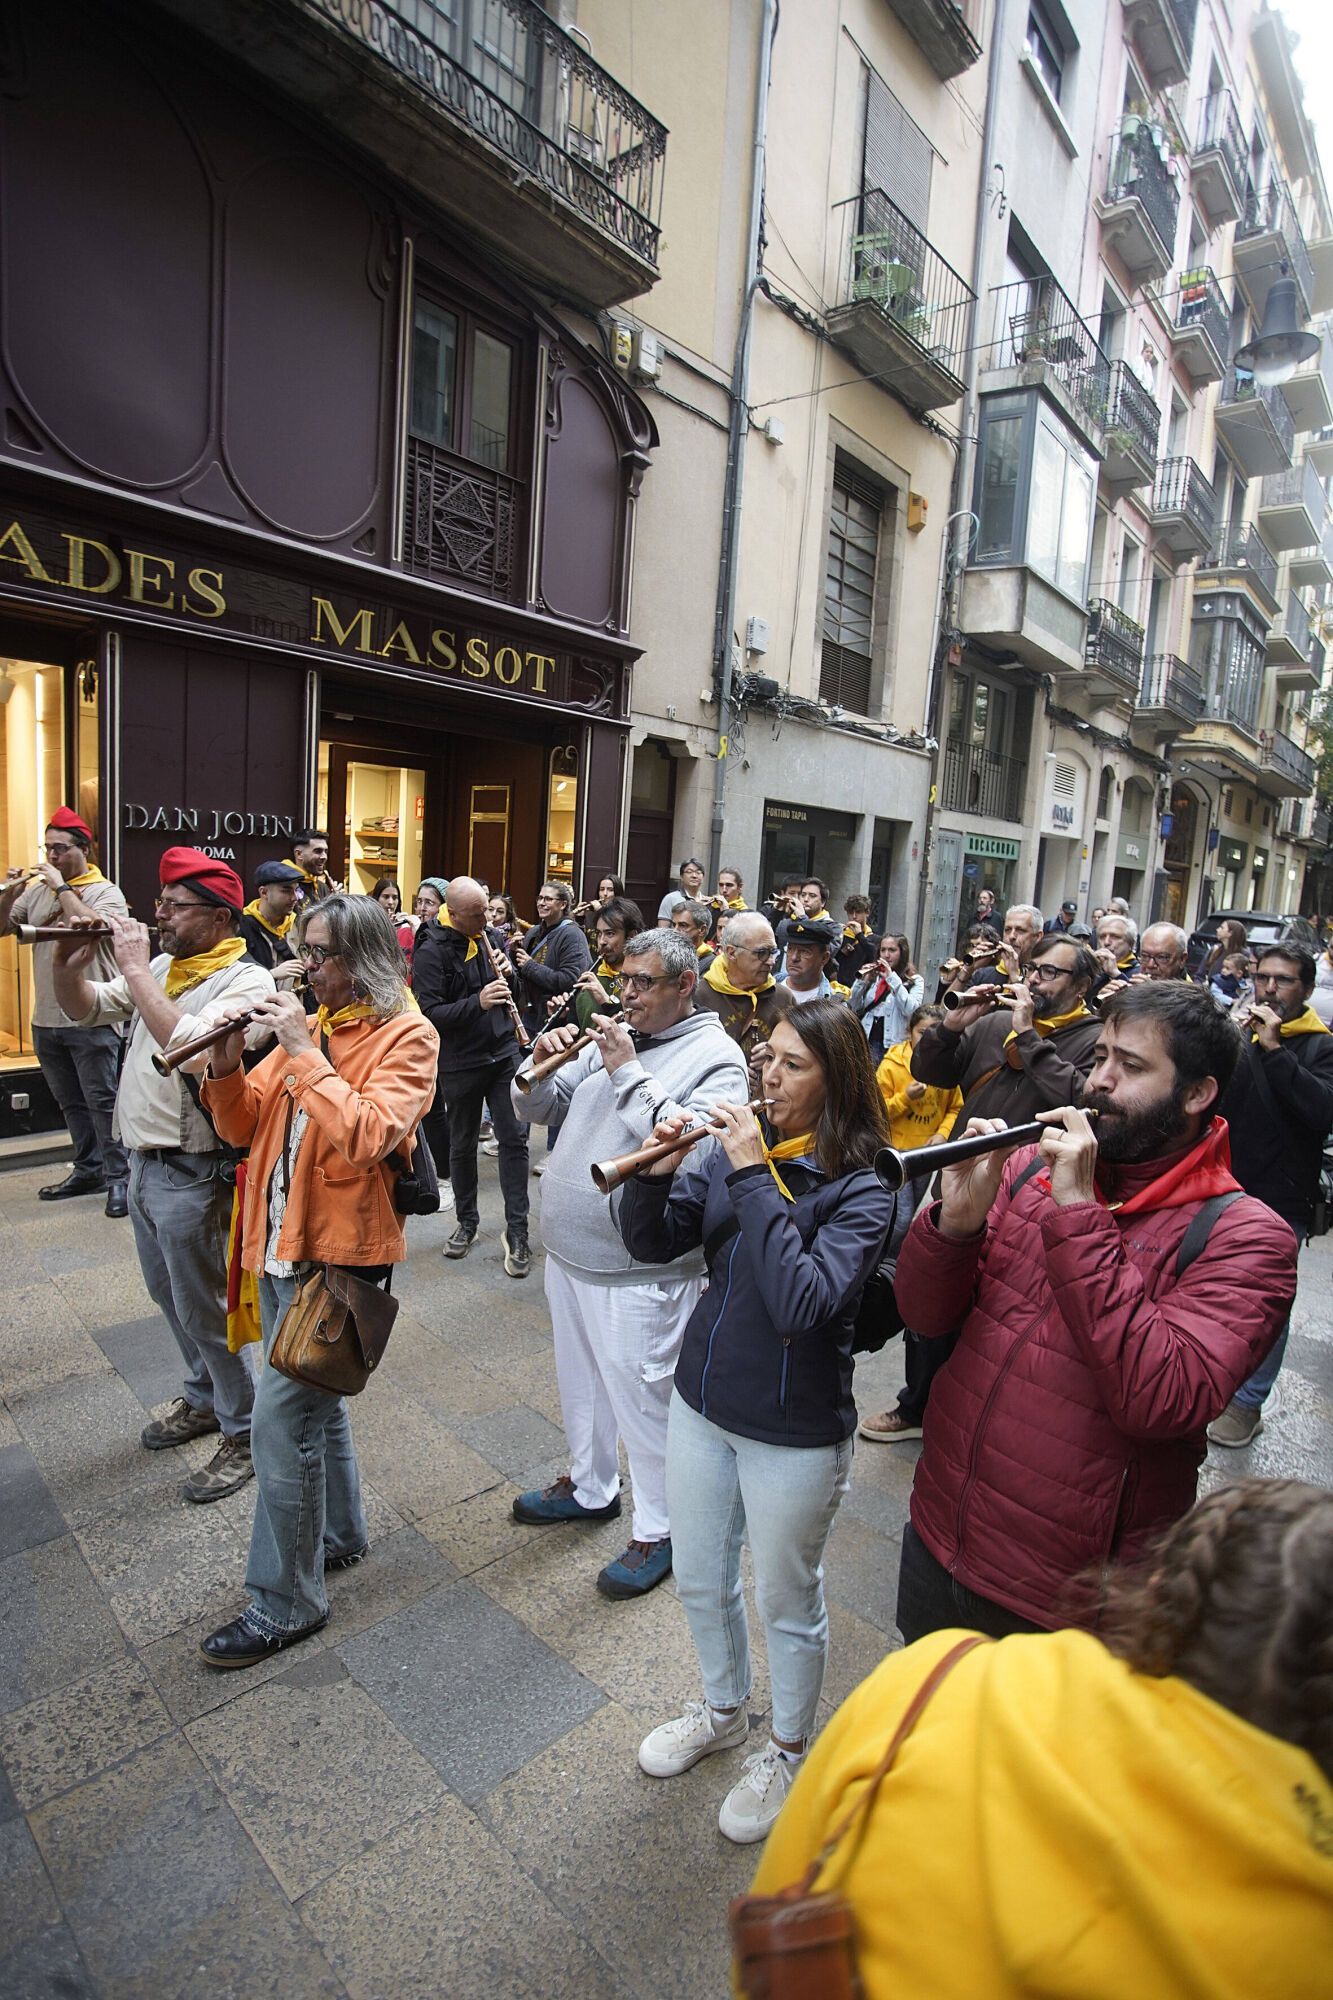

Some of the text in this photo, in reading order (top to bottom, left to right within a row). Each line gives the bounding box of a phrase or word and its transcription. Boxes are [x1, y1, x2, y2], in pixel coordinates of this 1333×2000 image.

[0, 521, 556, 693] ADES MASSOT
[124, 803, 296, 841] DAN JOHN
[766, 807, 807, 821] FORTINO TAPIA
